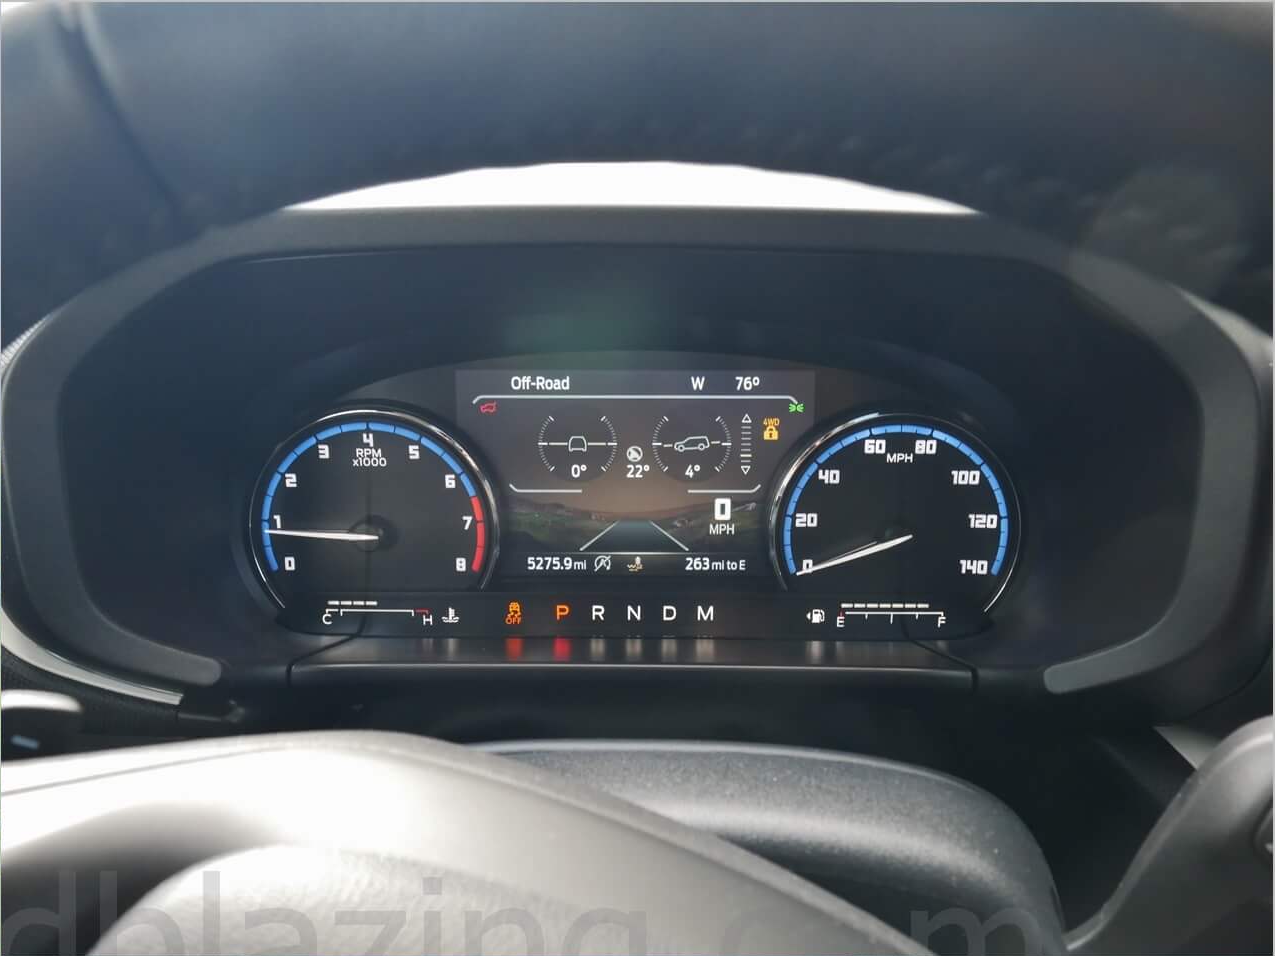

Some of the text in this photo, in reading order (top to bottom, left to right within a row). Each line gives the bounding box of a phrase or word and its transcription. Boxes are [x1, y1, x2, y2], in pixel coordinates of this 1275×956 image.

[510, 376, 570, 391] Off-Road
[691, 377, 705, 391] W
[763, 417, 780, 426] 4WD
[362, 433, 374, 447] 4
[864, 439, 886, 454] 60
[915, 439, 937, 455] 80
[318, 444, 330, 459] 3
[355, 448, 382, 458] RPM
[408, 444, 420, 459] 5
[886, 453, 913, 463] MPH
[352, 457, 387, 467] x1000
[285, 473, 297, 488] 2
[445, 474, 456, 488] 6
[818, 469, 840, 484] 40
[951, 470, 980, 485] 100
[714, 497, 731, 521] 0
[273, 514, 281, 528] 1
[462, 516, 473, 530] 7
[795, 513, 818, 528] 20
[968, 514, 998, 529] 120
[709, 523, 735, 536] MPH
[284, 557, 296, 571] 0
[456, 557, 467, 572] 8
[527, 556, 587, 571] 5275.9 mi
[685, 556, 746, 571] 263 mi to E
[803, 559, 813, 574] 0
[959, 560, 988, 575] 140
[322, 614, 332, 625] C
[423, 615, 433, 626] H
[556, 605, 714, 621] P R N D M
[837, 616, 845, 628] E
[937, 616, 946, 628] F
